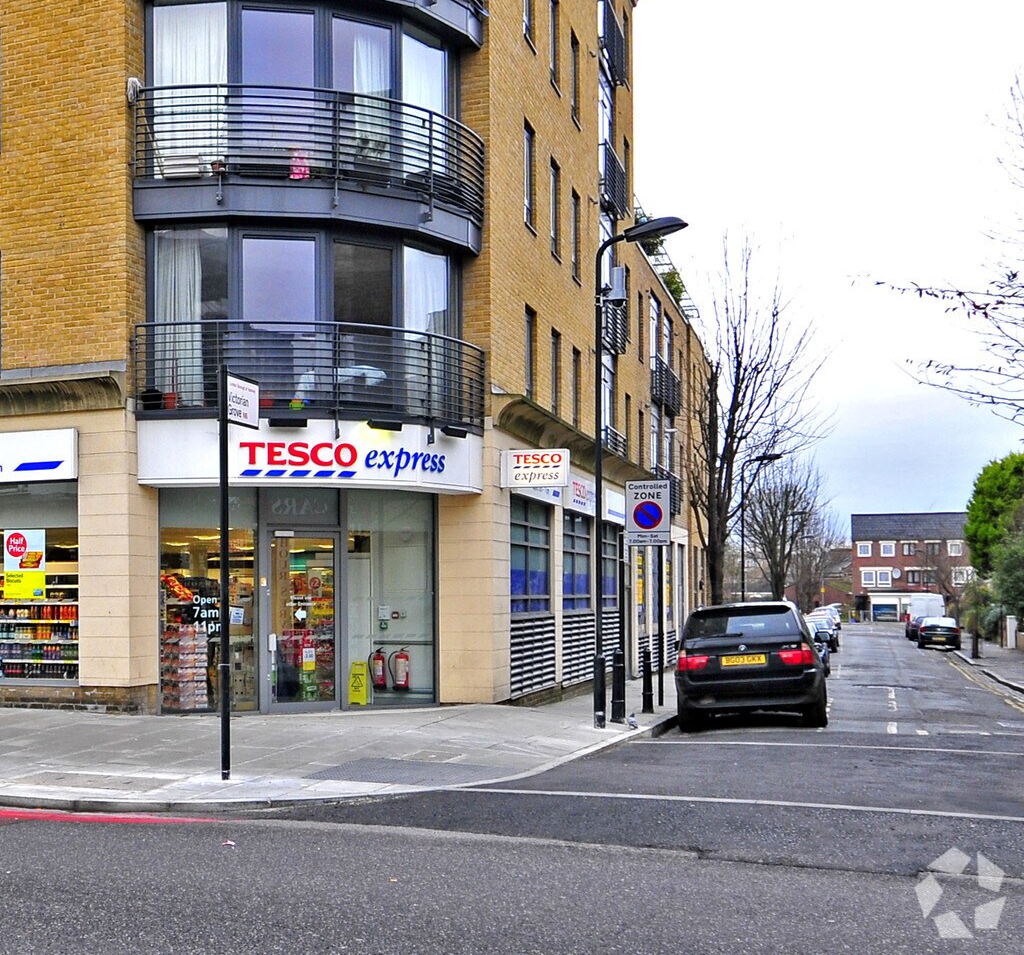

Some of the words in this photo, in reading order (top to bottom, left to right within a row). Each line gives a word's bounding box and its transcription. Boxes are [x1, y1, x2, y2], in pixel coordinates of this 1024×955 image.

[239, 442, 358, 467] TESCO
[364, 447, 446, 478] express
[513, 453, 562, 464] TESCO
[514, 472, 559, 483] express
[9, 537, 24, 545] Half
[192, 595, 218, 606] Open
[192, 606, 219, 618] 7am
[725, 656, 745, 664] BG03
